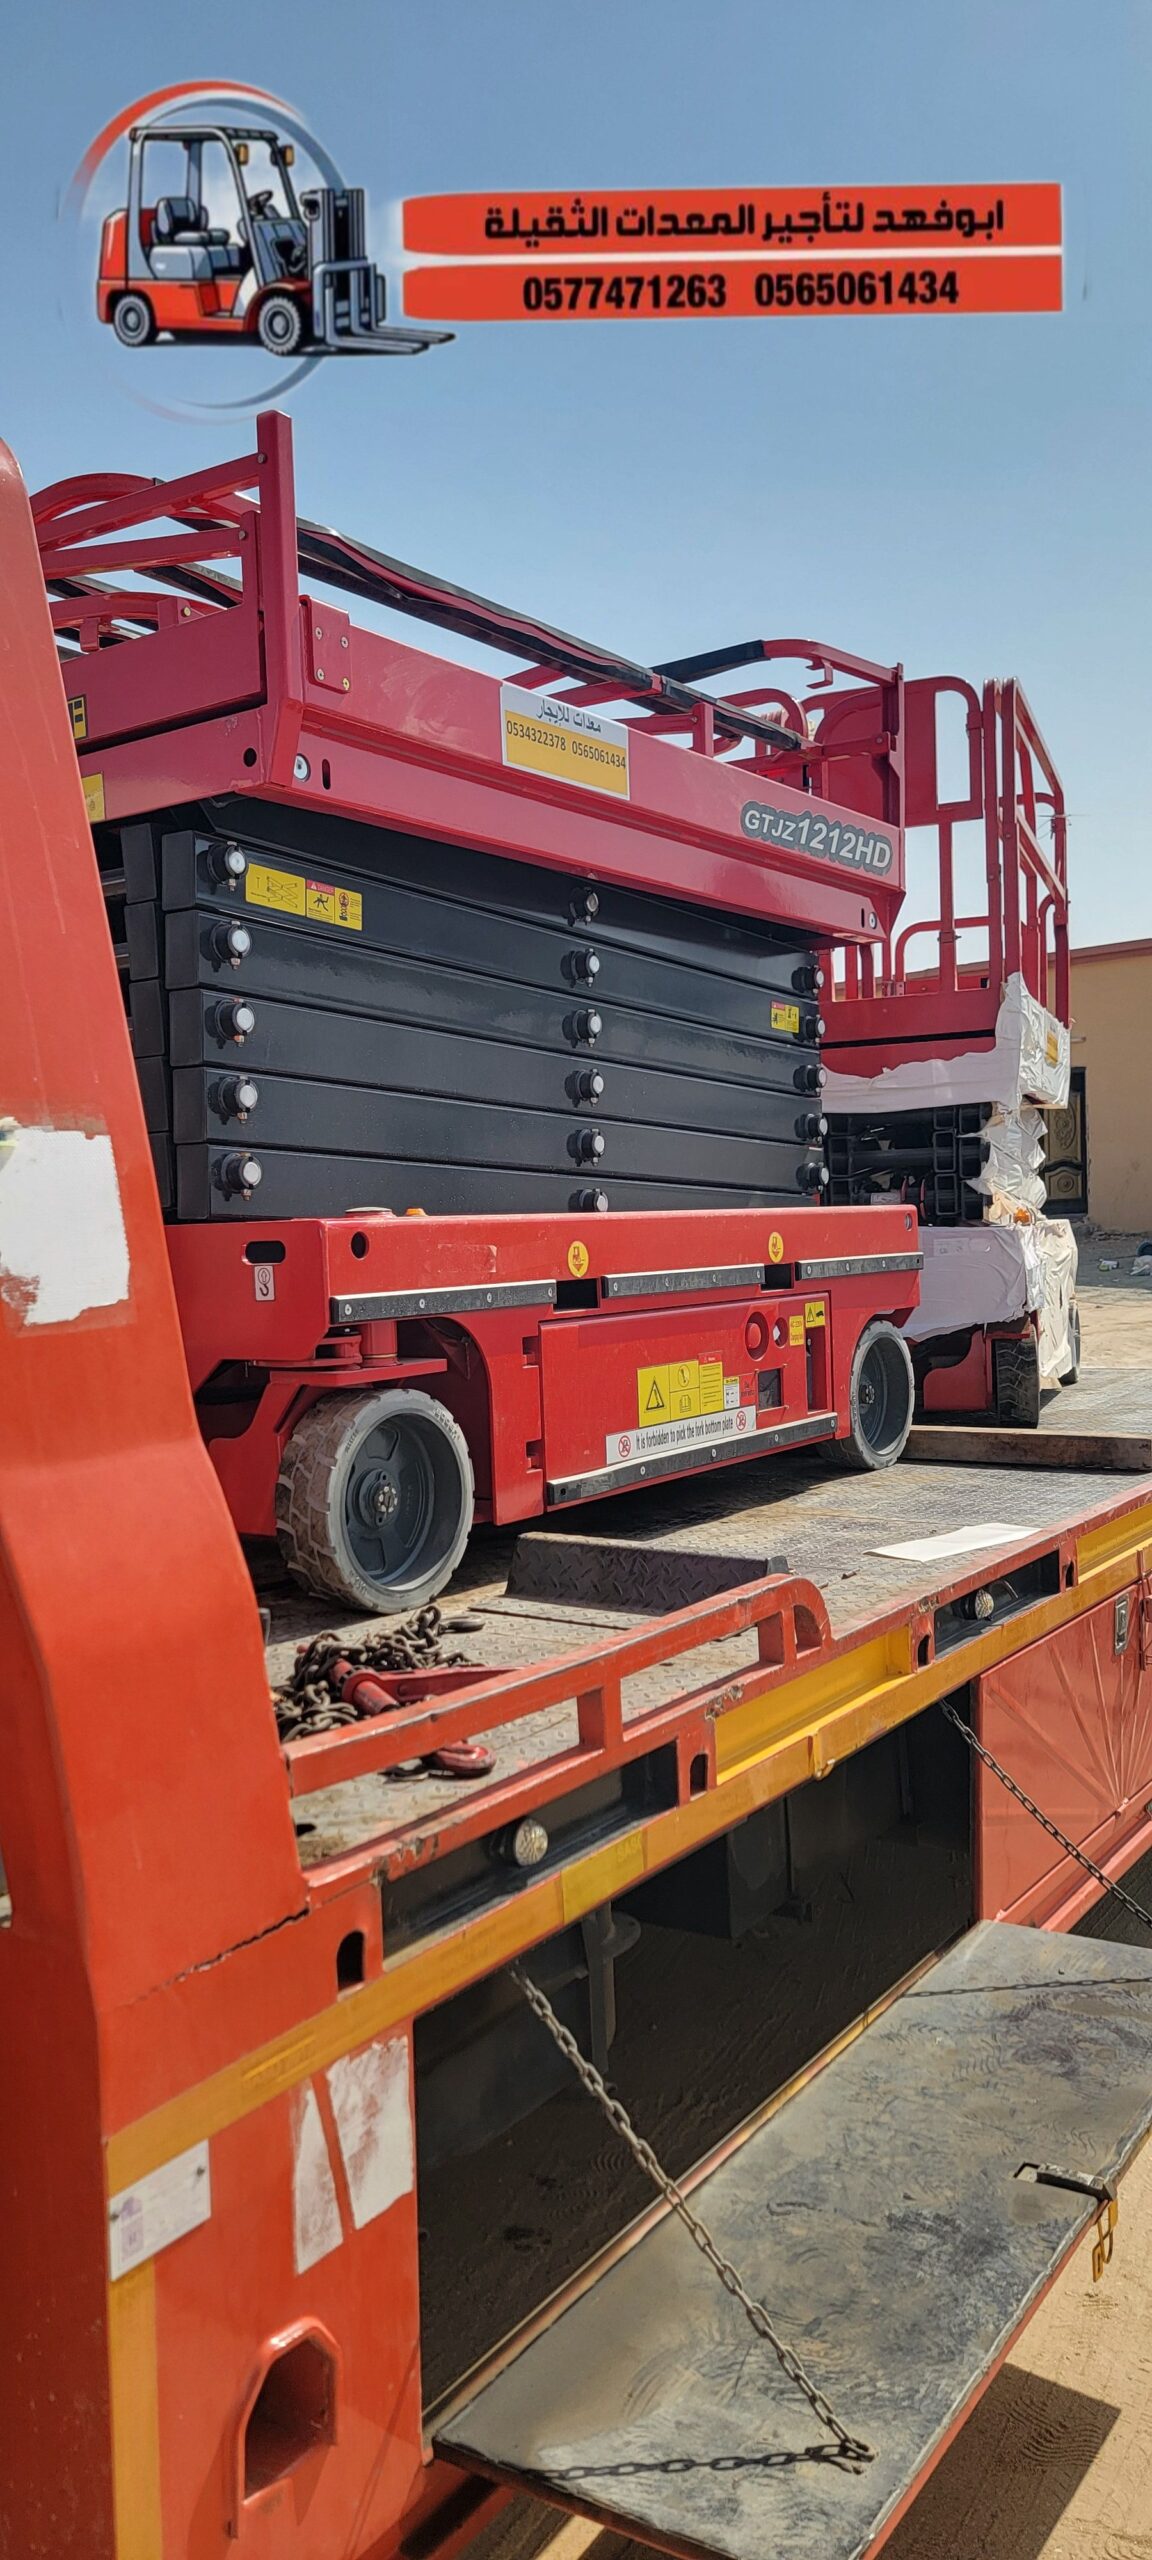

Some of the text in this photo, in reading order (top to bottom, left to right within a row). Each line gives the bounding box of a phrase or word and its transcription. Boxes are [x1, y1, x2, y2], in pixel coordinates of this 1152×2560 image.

[573, 712, 602, 733] معدات
[506, 720, 626, 769] 0534322378 0565061434
[745, 809, 891, 868] GTJZ1212HD
[635, 1434, 640, 1450] It
[641, 1434, 645, 1449] is
[646, 1429, 669, 1448] forbidden
[670, 1428, 675, 1442] to
[676, 1424, 686, 1445] pick
[695, 1420, 704, 1436] fork
[705, 1418, 721, 1434] bottom
[722, 1416, 733, 1434] plate
